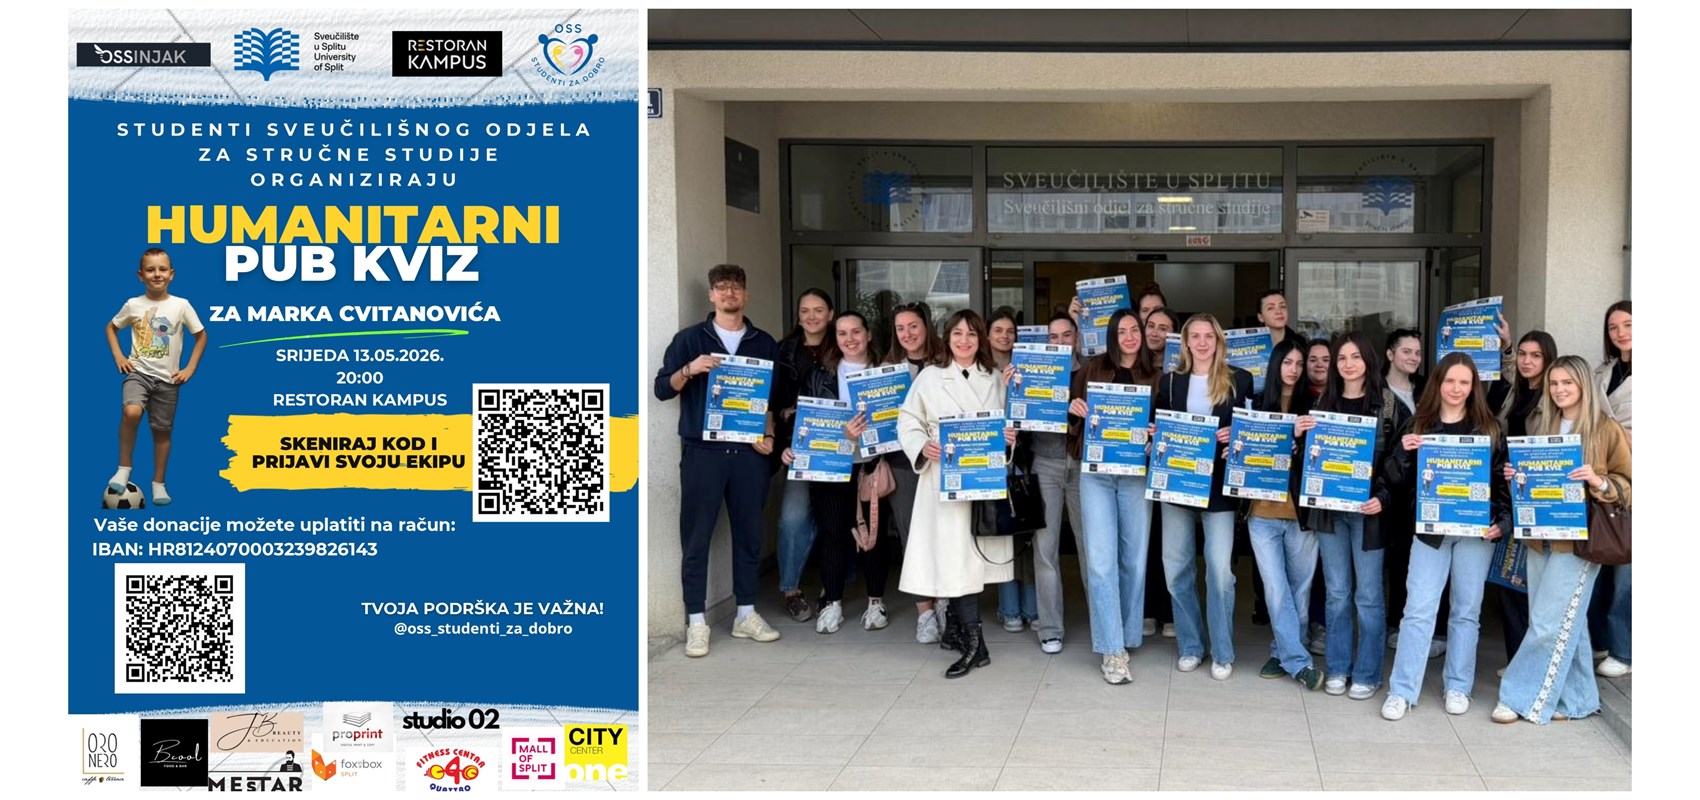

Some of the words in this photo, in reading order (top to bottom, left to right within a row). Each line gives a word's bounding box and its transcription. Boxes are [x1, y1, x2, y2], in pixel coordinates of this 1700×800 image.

[555, 23, 582, 34] OSS
[314, 31, 360, 42] Sveučilište
[322, 42, 347, 52] Splitu
[408, 39, 487, 52] RESTORAN
[100, 49, 187, 64] OSSINJAK
[314, 53, 357, 63] University
[408, 54, 487, 70] KAMPUS
[314, 63, 323, 72] of
[324, 63, 344, 73] Split
[531, 56, 566, 87] STUDENTI
[568, 79, 581, 87] ZA
[582, 56, 606, 83] DOBRO
[117, 122, 250, 137] STUDENTI
[267, 118, 469, 137] SVEUČILIŠNOG
[485, 122, 590, 137] ODJELA
[198, 147, 230, 162] ZA
[246, 143, 369, 162] STRUČNE
[385, 147, 498, 162] STUDIJE
[250, 172, 456, 187] ORGANIZIRAJU
[1003, 168, 1158, 190] SVEUČILIŠTE
[1165, 172, 1181, 190] U
[1188, 172, 1272, 190] SPLITU
[1004, 198, 1088, 215] Sveučilišni
[1093, 199, 1132, 218] odjel
[1136, 203, 1154, 215] za
[1218, 199, 1271, 218] studije
[147, 205, 560, 244] HUMANITARNI
[225, 246, 336, 281] PUB
[354, 246, 479, 281] KVIZ
[209, 305, 242, 322] ZA
[247, 305, 334, 322] MARKA
[339, 301, 502, 322] CVITANOVIĆA
[276, 348, 350, 362] SRIJEDA
[353, 348, 445, 362] 13.05.2026.
[336, 371, 384, 385] 20:00
[273, 393, 367, 407] RESTORAN
[372, 393, 448, 407] KAMPUS
[280, 436, 377, 451] SKENIRAJ
[382, 436, 426, 451] KOD
[431, 436, 437, 451] I
[252, 454, 330, 469] PRIJAVI
[335, 454, 401, 469] SVOJU
[406, 454, 466, 469] EKIPU
[1426, 457, 1482, 466] HUMANITARNI
[1518, 459, 1574, 467] HUMANITARNI
[94, 517, 139, 532] Vaše
[143, 516, 221, 536] donacije
[226, 517, 295, 532] možete
[300, 516, 365, 536] uplatiti
[370, 520, 393, 532] na
[398, 517, 456, 532] račun:
[92, 542, 143, 557] IBAN:
[148, 542, 378, 557] HR8124070003239826143
[361, 602, 419, 615] TVOJA
[424, 599, 510, 615] PODRŠKA
[513, 602, 534, 615] JE
[537, 599, 604, 615] VAŽNA!
[394, 621, 573, 637] @oss_studenti_za_dobro
[402, 708, 466, 730] studio
[468, 708, 500, 730] 02
[332, 728, 384, 742] proprint
[568, 728, 624, 746] CITY
[88, 733, 118, 753] ORO
[519, 745, 549, 753] MALL
[569, 746, 604, 755] CENTER
[88, 753, 118, 768] NERO
[416, 748, 451, 769] FITNESS
[518, 754, 533, 763] OF
[518, 763, 548, 773] SPLIT
[564, 763, 629, 782] one
